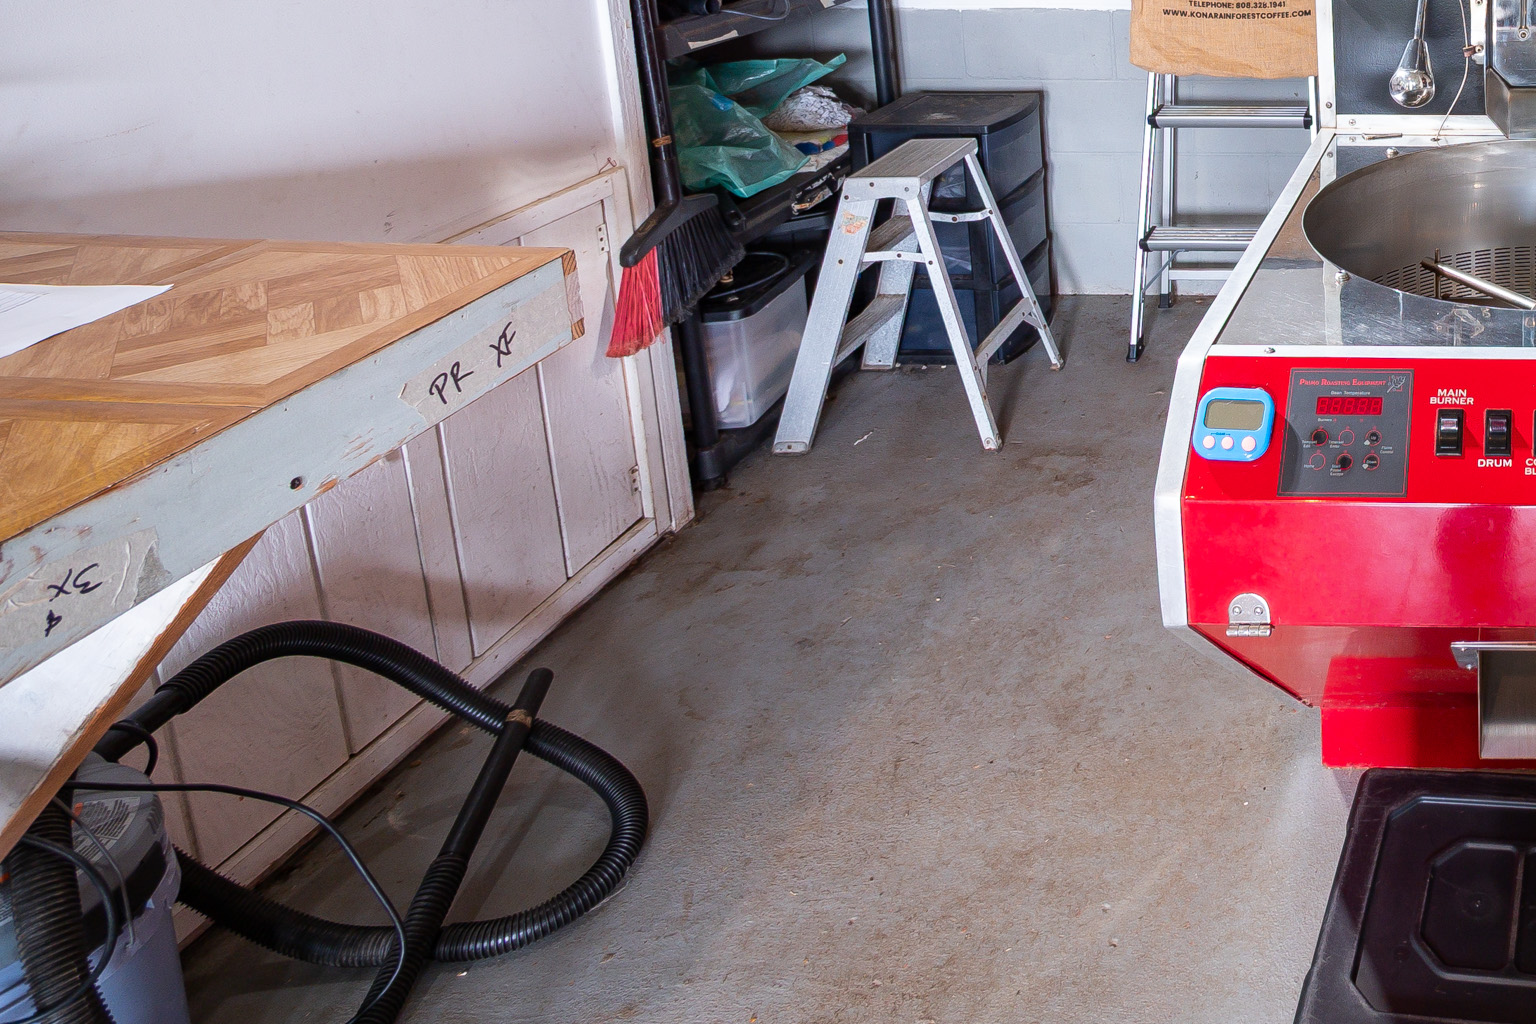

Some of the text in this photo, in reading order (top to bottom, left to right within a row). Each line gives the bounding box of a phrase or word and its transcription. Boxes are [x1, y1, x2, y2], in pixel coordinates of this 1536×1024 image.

[1188, 0, 1234, 9] TELEPHONE:
[1162, 8, 1312, 20] WWW.KONARAINFORESTCOFFEE.COM
[428, 361, 475, 404] PR
[1436, 389, 1467, 397] MAIN
[1429, 397, 1474, 405] BURNER
[1477, 459, 1512, 467] DRUM
